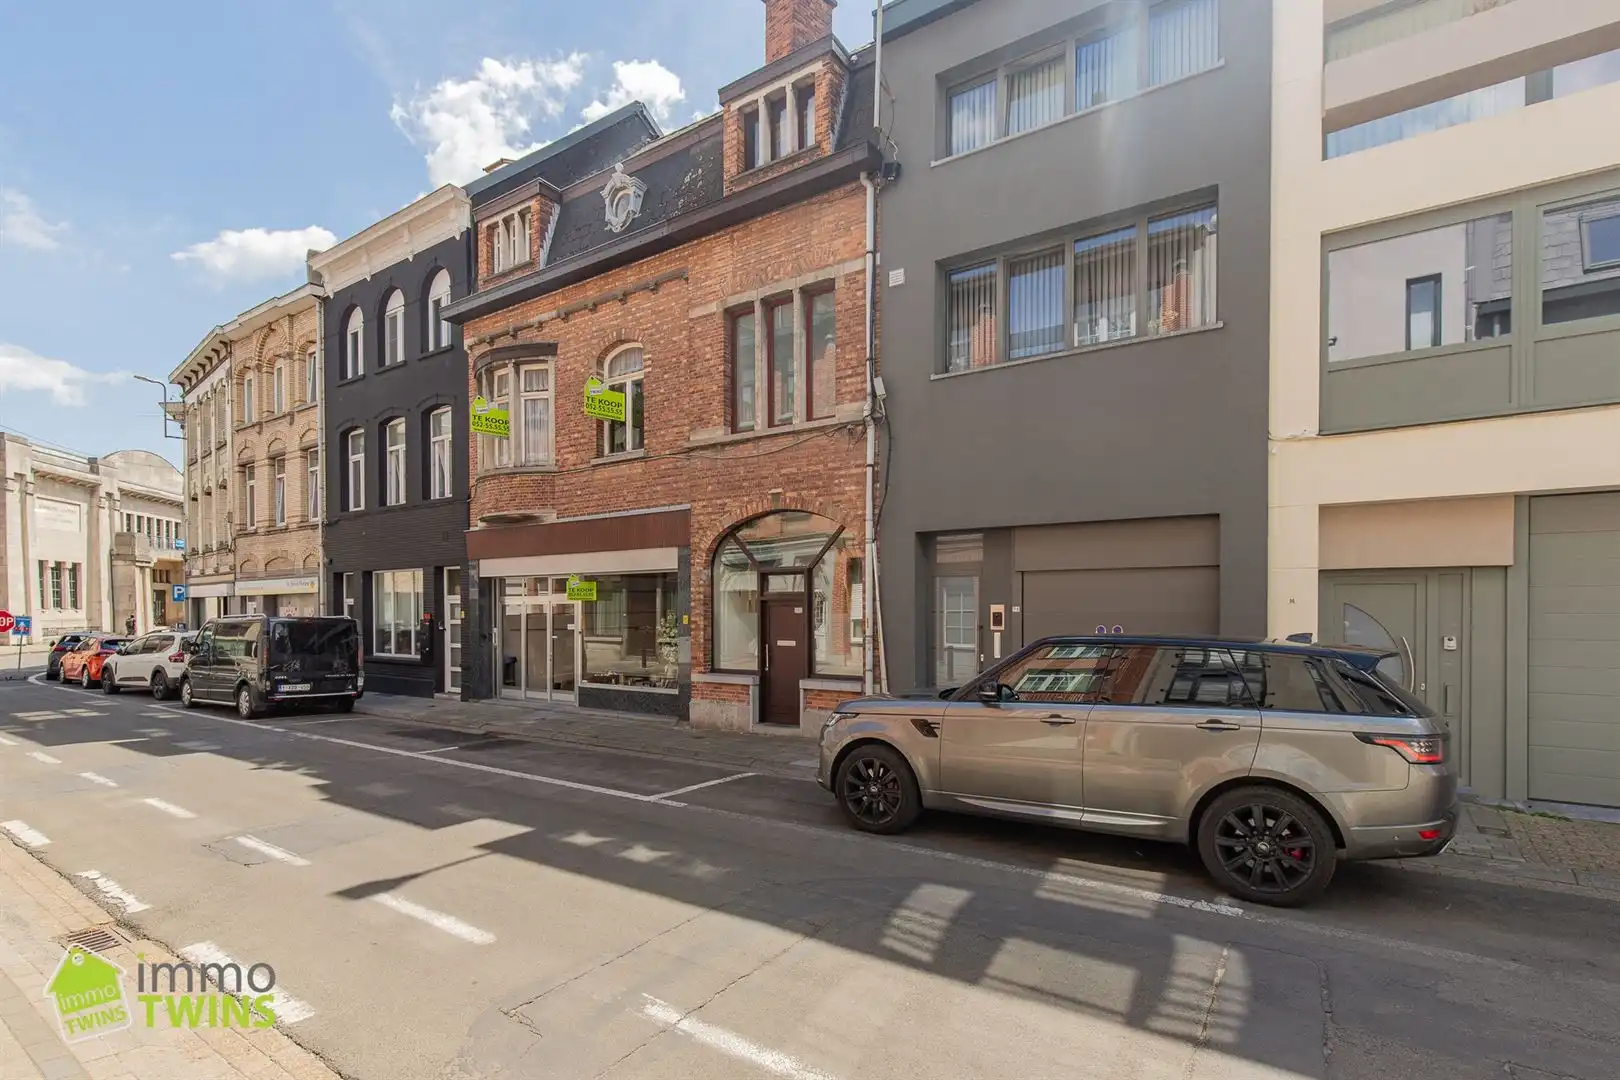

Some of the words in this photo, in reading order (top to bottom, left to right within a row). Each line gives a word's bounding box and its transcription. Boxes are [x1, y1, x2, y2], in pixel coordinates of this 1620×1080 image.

[598, 399, 623, 408] KOOP
[485, 416, 509, 425] KOOP
[174, 586, 185, 600] P
